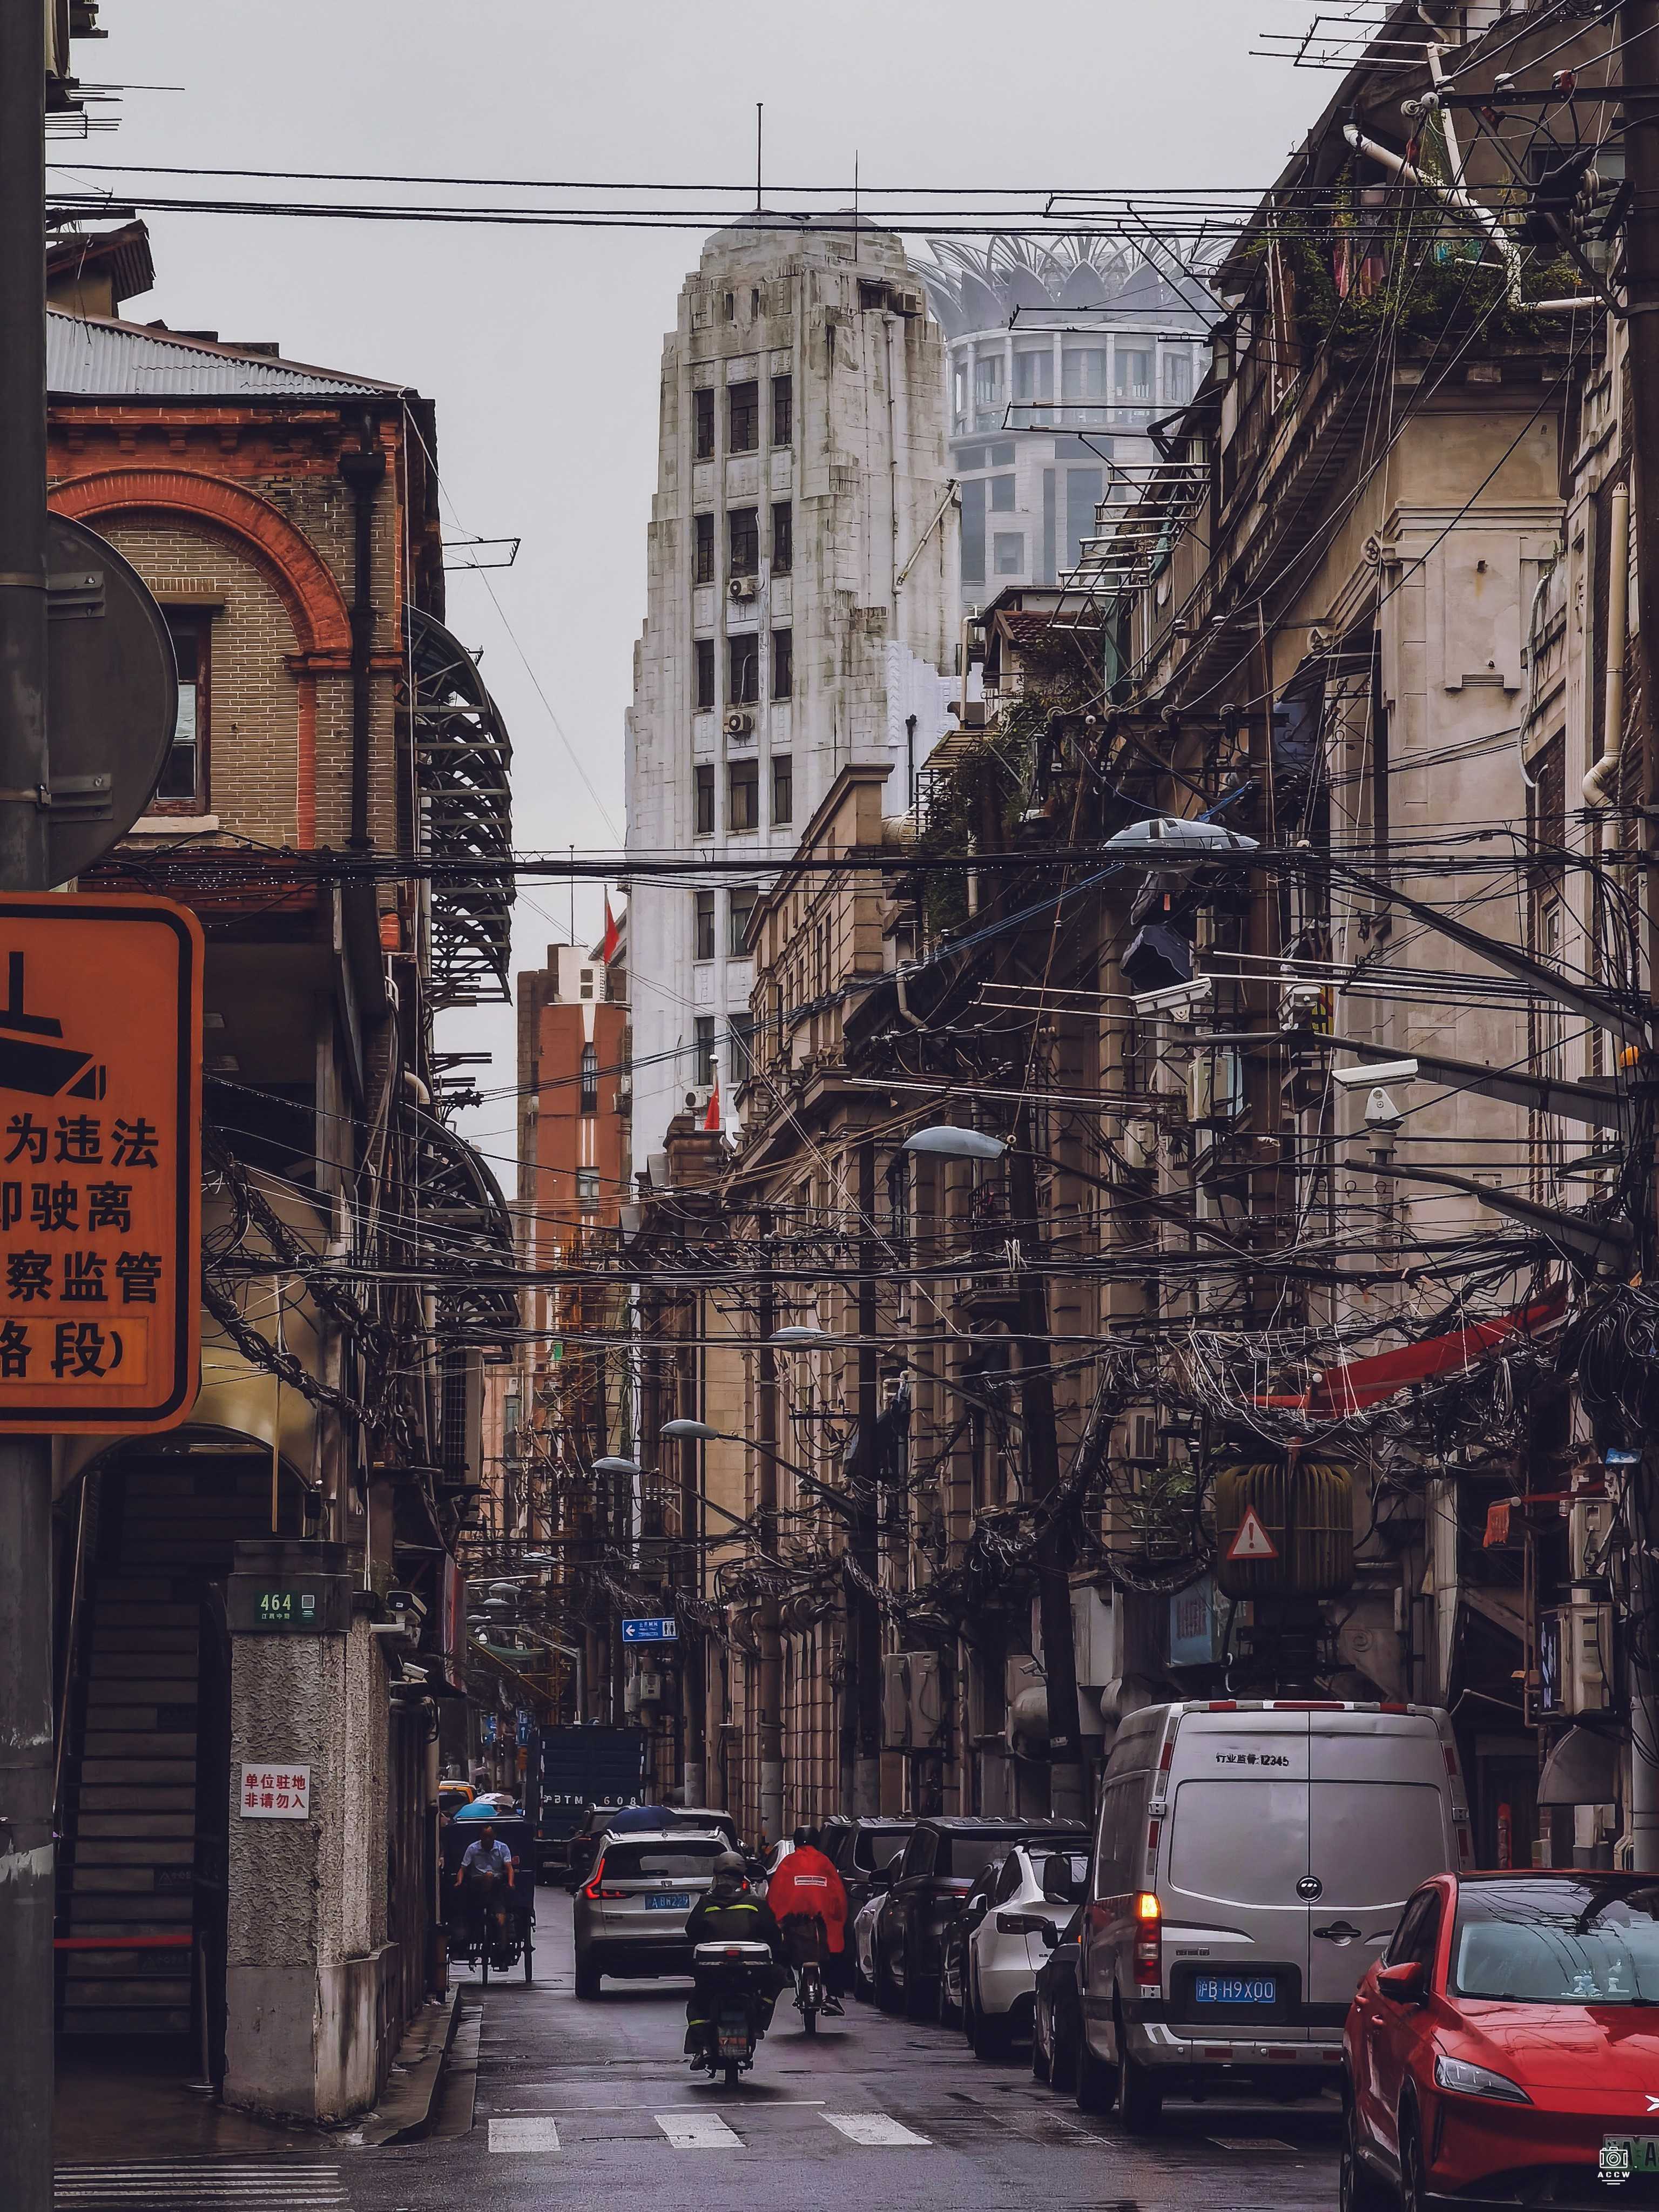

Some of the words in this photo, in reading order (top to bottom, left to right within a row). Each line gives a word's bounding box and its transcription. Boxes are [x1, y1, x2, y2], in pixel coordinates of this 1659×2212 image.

[4, 1112, 159, 1169] 为违法
[5, 1249, 162, 1304] 察监管
[260, 1594, 291, 1611] 464
[245, 1773, 306, 1790] 单位驻地
[244, 1792, 306, 1809] 非请勿入
